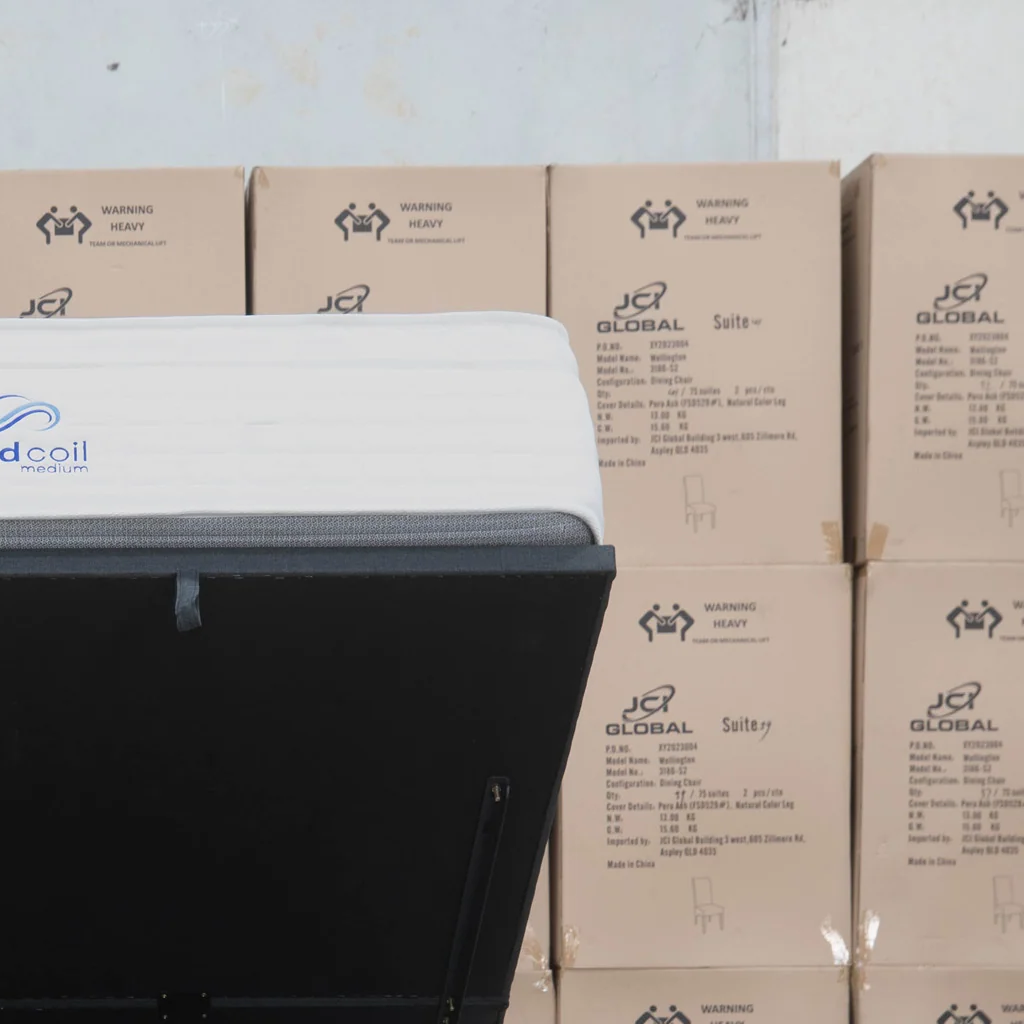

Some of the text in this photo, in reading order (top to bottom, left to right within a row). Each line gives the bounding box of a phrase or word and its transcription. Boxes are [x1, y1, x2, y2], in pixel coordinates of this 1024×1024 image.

[400, 202, 453, 212] WARNING
[696, 198, 749, 209] WARNING
[101, 205, 154, 215] WARNING
[409, 219, 443, 229] HEAVY
[705, 215, 740, 226] HEAVY
[110, 222, 145, 232] HEAVY
[714, 313, 749, 331] Suite
[916, 311, 1005, 325] GLOBAL
[597, 318, 685, 334] GLOBAL
[20, 464, 88, 473] medium
[704, 602, 757, 612] WARNING
[713, 619, 748, 629] HEAVY
[605, 721, 694, 736] GLOBAL
[722, 716, 758, 733] Suite
[910, 719, 999, 732] GLOBAL
[701, 1004, 754, 1014] WARNING
